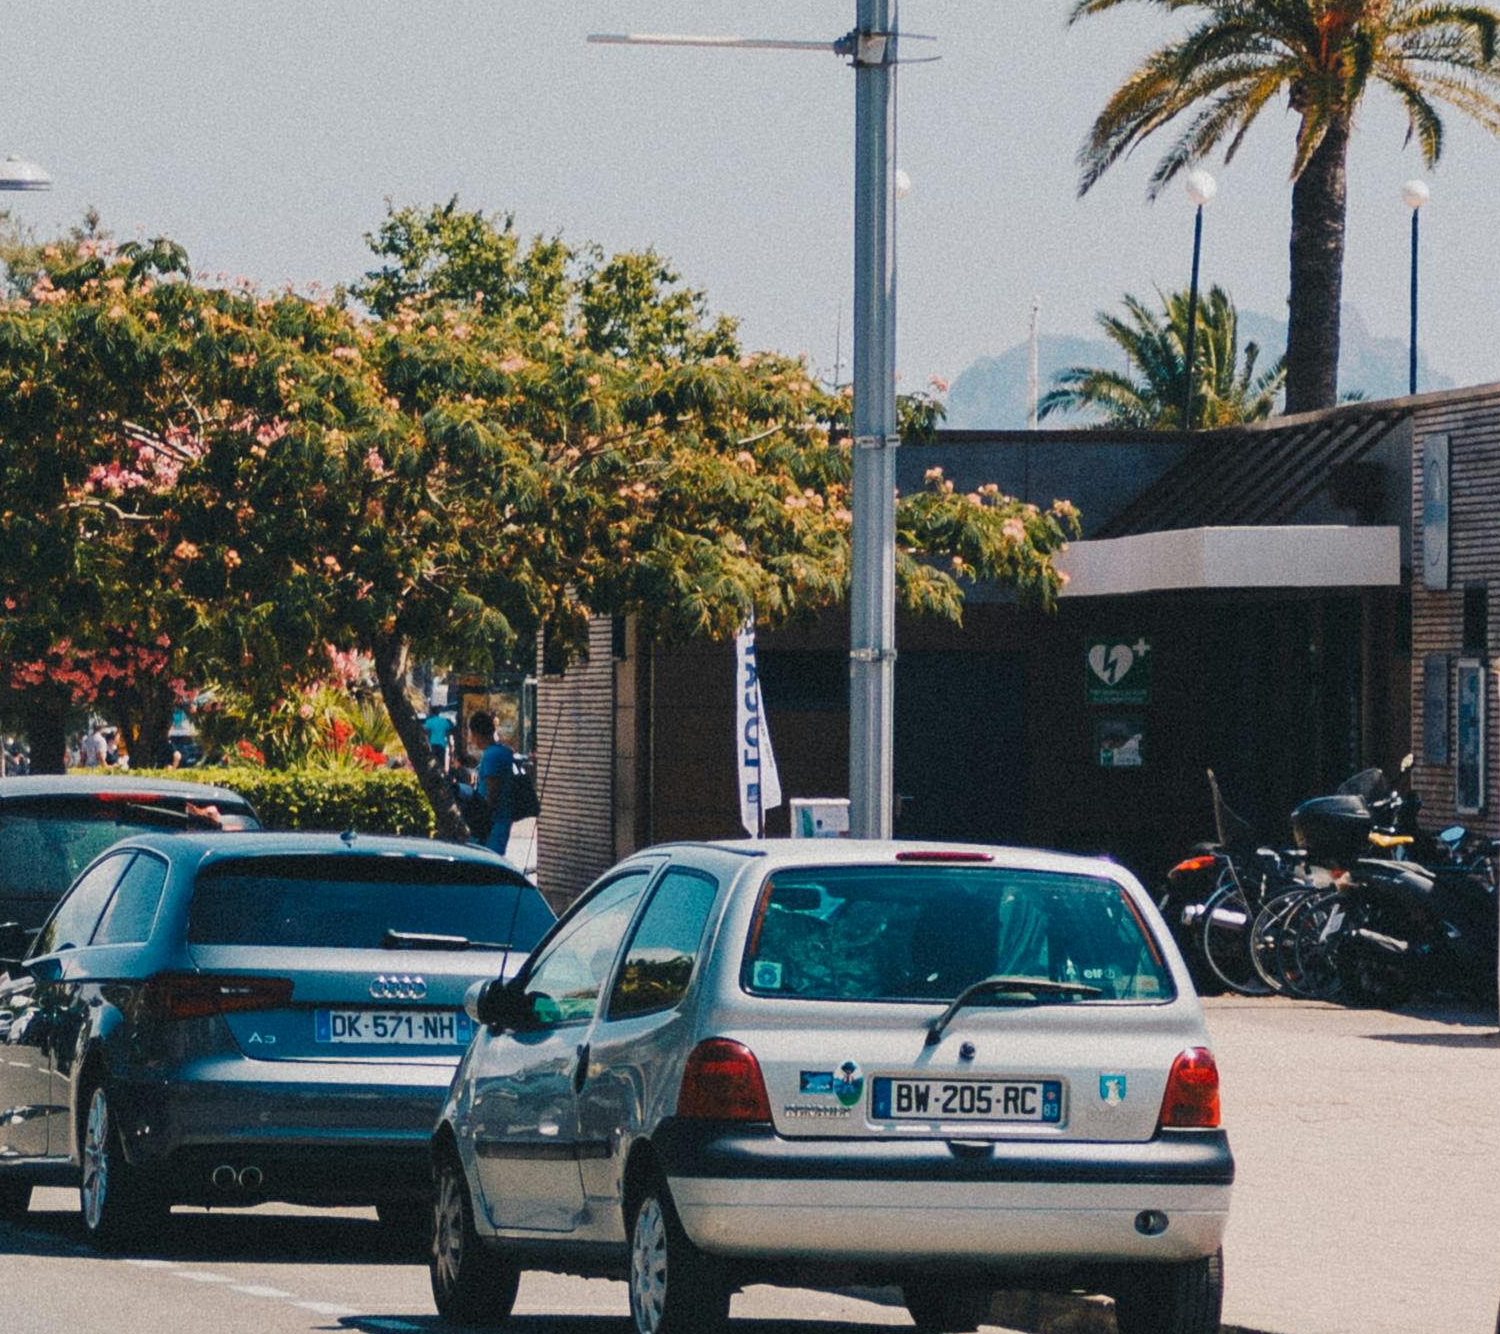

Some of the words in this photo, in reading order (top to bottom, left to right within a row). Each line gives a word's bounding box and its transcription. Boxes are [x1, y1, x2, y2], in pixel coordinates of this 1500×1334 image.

[1082, 968, 1104, 979] elf
[331, 1014, 454, 1040] DK-571-NH
[247, 1031, 277, 1044] A3
[895, 1083, 1039, 1115] BW-205-RC
